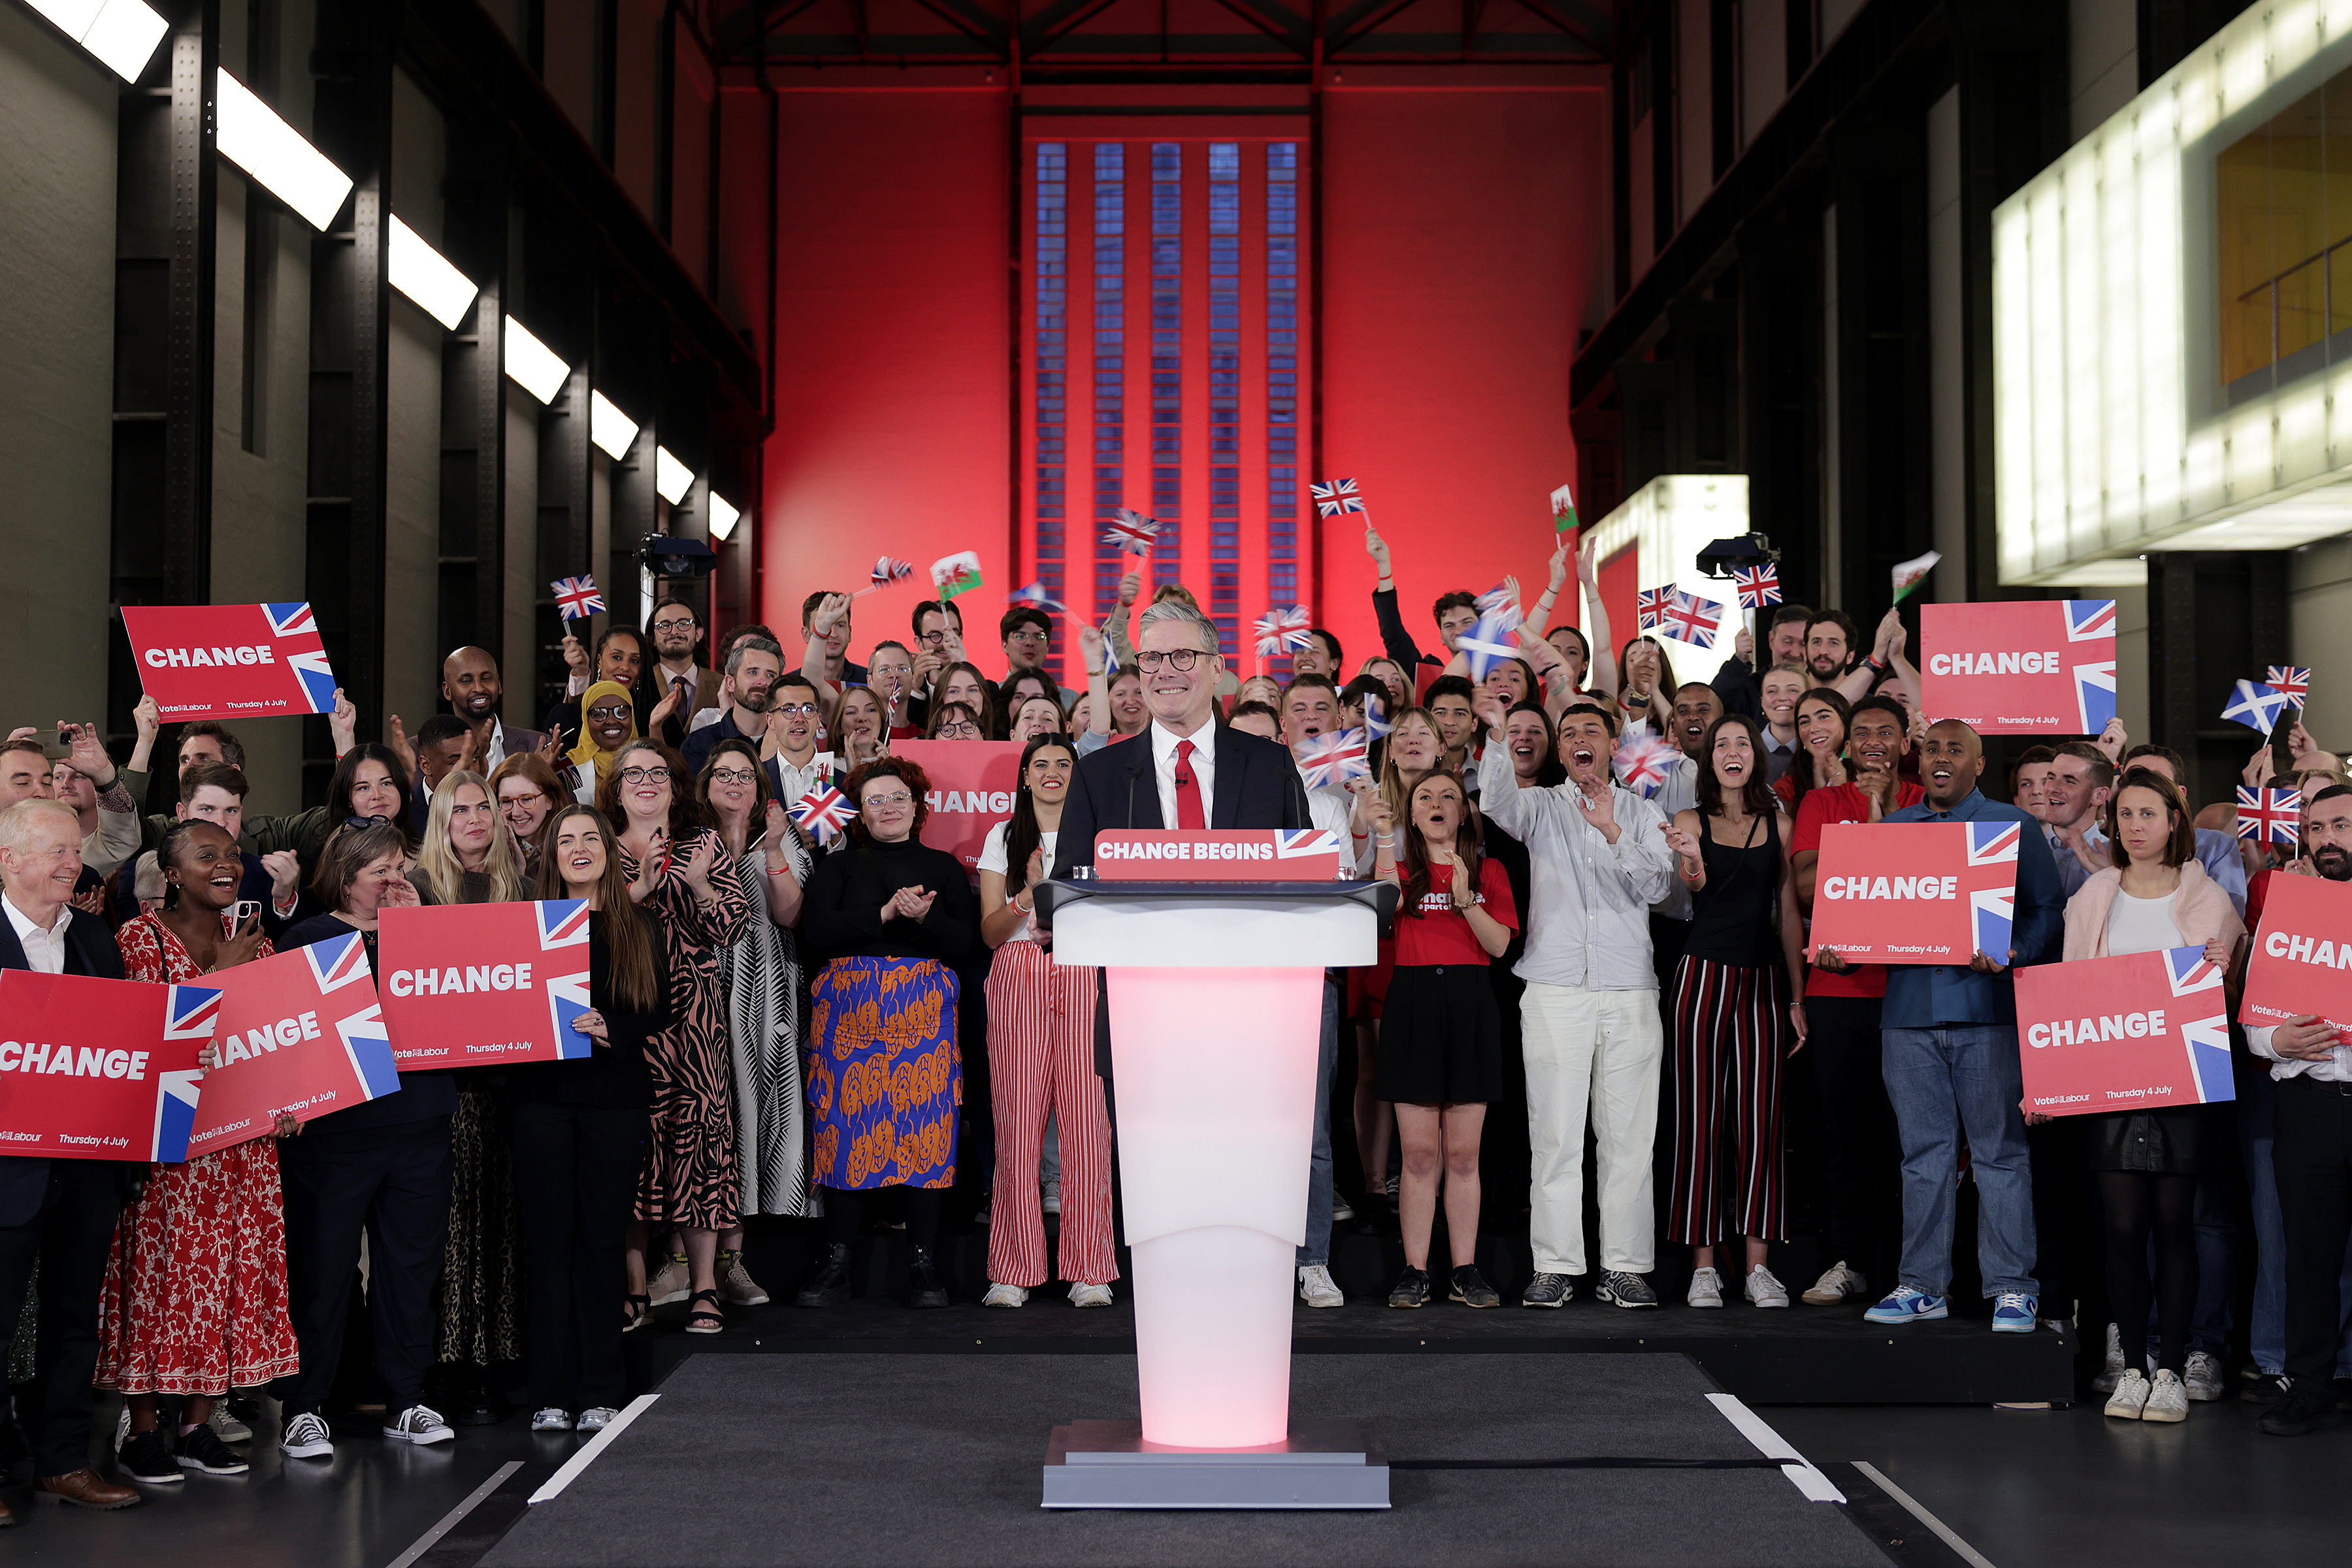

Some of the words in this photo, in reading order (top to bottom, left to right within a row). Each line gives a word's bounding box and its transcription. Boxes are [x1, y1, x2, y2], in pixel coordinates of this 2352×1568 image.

[144, 645, 275, 668] CHANGE
[1929, 651, 2060, 676] CHANGE
[226, 700, 263, 709] Thursday
[1997, 716, 2034, 725] Thursday
[2042, 716, 2059, 725] July
[924, 790, 1017, 814] HANG
[1097, 841, 1190, 860] CHANGE
[1193, 842, 1273, 860] BEGINS
[1823, 876, 1958, 900] CHANGE
[1424, 904, 1443, 912] part
[1887, 945, 1925, 955] Thursday
[1933, 945, 1951, 955] July
[2265, 931, 2352, 972] CHAN
[389, 962, 532, 997] CHANGE
[2250, 1004, 2272, 1015] Vote
[2027, 1009, 2167, 1049] CHANGE
[213, 1010, 322, 1070] ANGE
[465, 1042, 506, 1054] Thursday
[507, 1042, 514, 1051] 4
[514, 1041, 532, 1051] July
[419, 1047, 449, 1056] Labour
[0, 1041, 150, 1081] CHANGE
[310, 1095, 318, 1104] 4
[318, 1090, 336, 1102] July
[2033, 1096, 2055, 1106] Vote
[2063, 1094, 2090, 1103] Labour
[2105, 1089, 2146, 1100] Thursday
[2154, 1085, 2172, 1096] July
[10, 1131, 43, 1142] Labour
[189, 1131, 213, 1144] Vote
[220, 1118, 251, 1134] Labour
[59, 1134, 103, 1148] Thursday
[102, 1136, 109, 1145] 4
[110, 1136, 129, 1149] July
